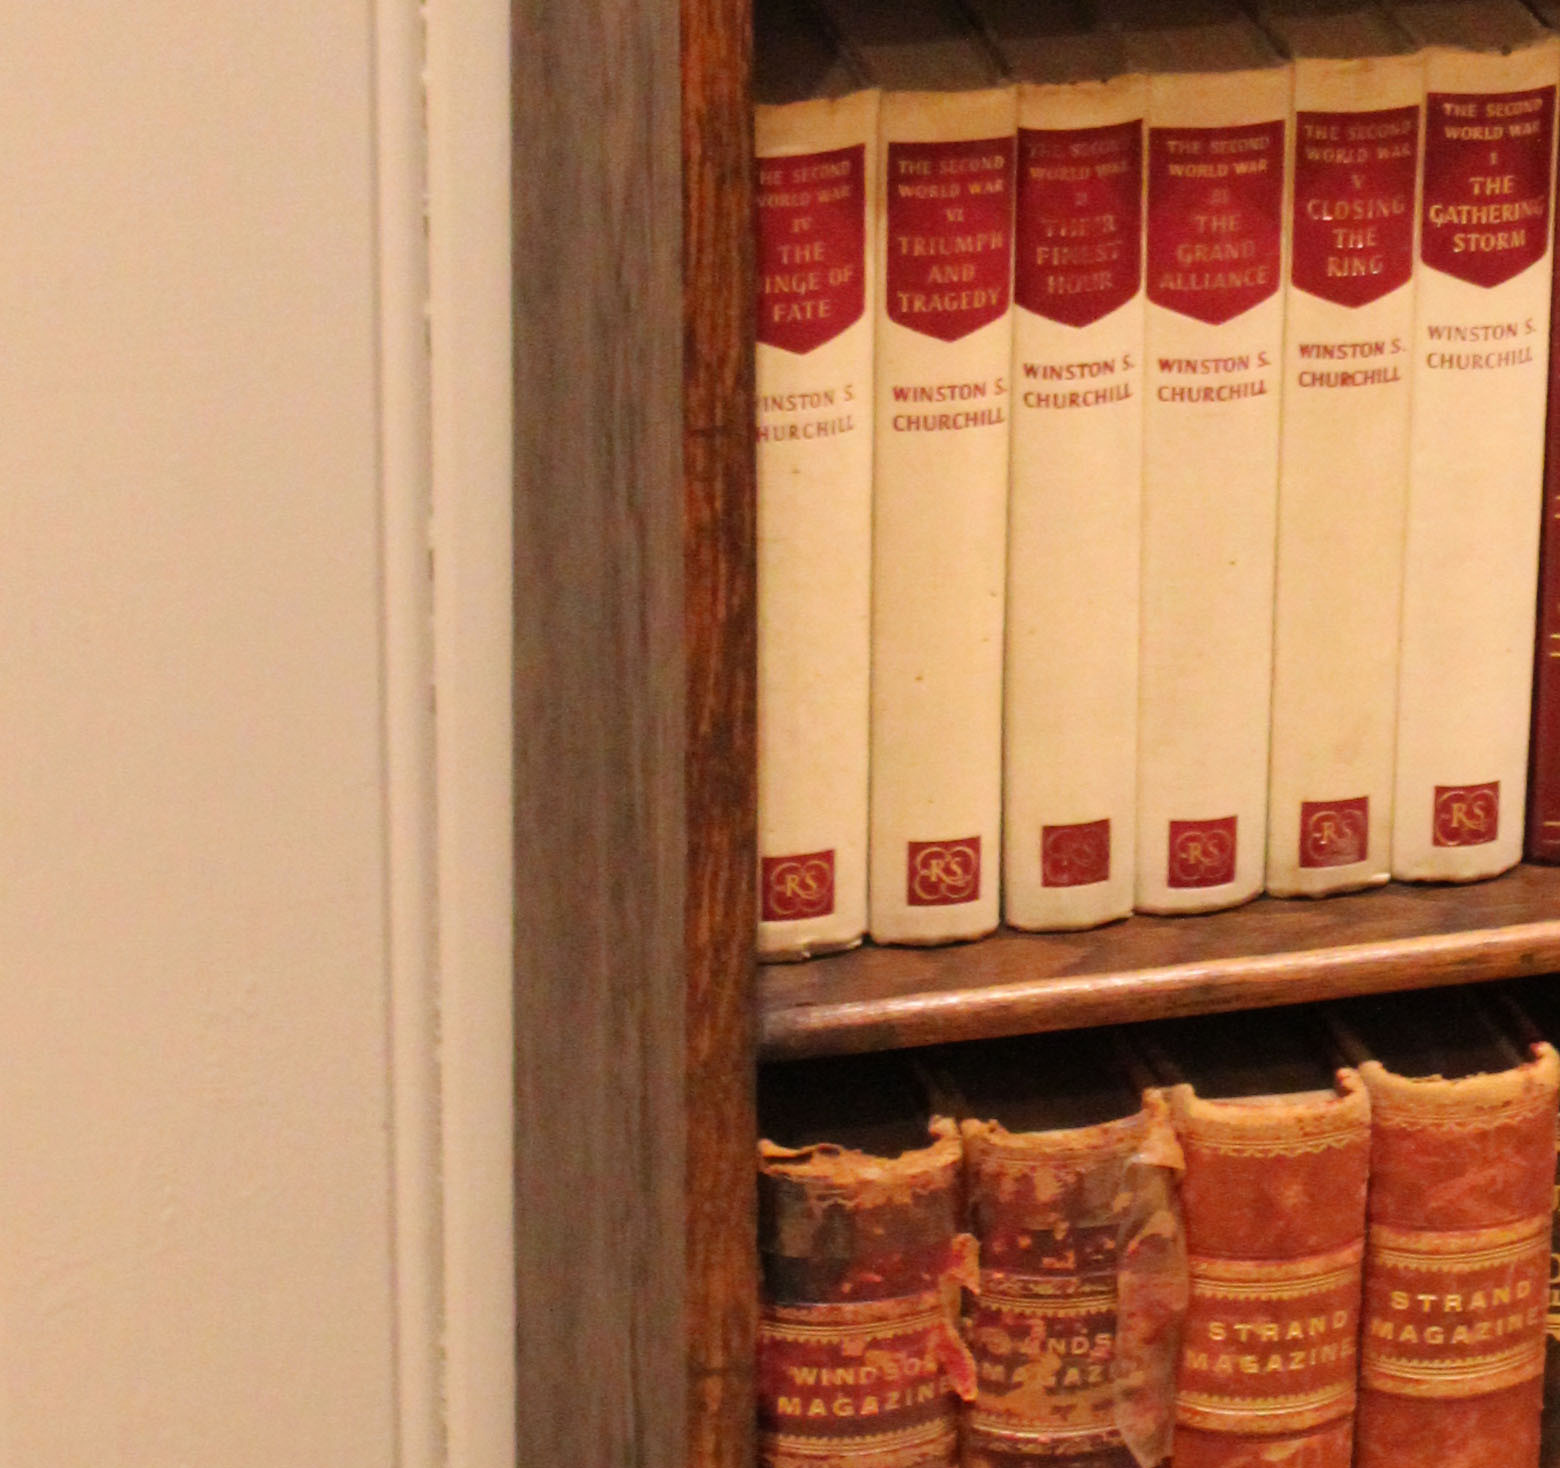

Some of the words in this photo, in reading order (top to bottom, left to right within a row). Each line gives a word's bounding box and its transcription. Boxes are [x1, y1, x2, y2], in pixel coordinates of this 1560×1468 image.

[1443, 103, 1479, 118] THE
[1486, 99, 1543, 116] SECOND
[1444, 126, 1503, 140] WORLD
[1508, 121, 1541, 137] WAR
[899, 160, 931, 175] THE
[1168, 164, 1229, 178] WORLD
[1234, 160, 1268, 175] WAR
[898, 183, 960, 199] WORLD
[1469, 176, 1515, 195] THE
[1307, 198, 1405, 221] CLOSING
[1429, 195, 1545, 227] GATHERING
[1194, 214, 1240, 233] THE
[898, 234, 1003, 257] TRIUMPH
[1332, 228, 1376, 248] THE
[1453, 230, 1526, 253] STORM
[777, 242, 825, 265] THE
[1176, 240, 1256, 264] GRAND
[829, 267, 854, 287] OF
[927, 265, 975, 284] AND
[1327, 256, 1384, 277] RING
[1159, 267, 1269, 291] ALLIANCE
[773, 300, 832, 322] FATE
[898, 290, 1000, 314] TRAGEDY
[1427, 324, 1518, 342] WINSTON
[1299, 342, 1385, 360] WINSTON
[1426, 347, 1533, 370] CHURCHILL
[1023, 358, 1115, 380] WINSTON
[1158, 357, 1249, 375] WINSTON
[1298, 366, 1401, 388] CHURCHILL
[893, 381, 986, 403] WINSTON
[1022, 383, 1132, 410] CHURCHILL
[1157, 379, 1267, 403] CHURCHILL
[893, 407, 1005, 432] CHURCHILL
[1390, 1280, 1531, 1312] STRAND
[1208, 1310, 1348, 1342] STRAND
[1370, 1305, 1540, 1345] MAGAZINE
[1185, 1335, 1356, 1374] MAGAZINE
